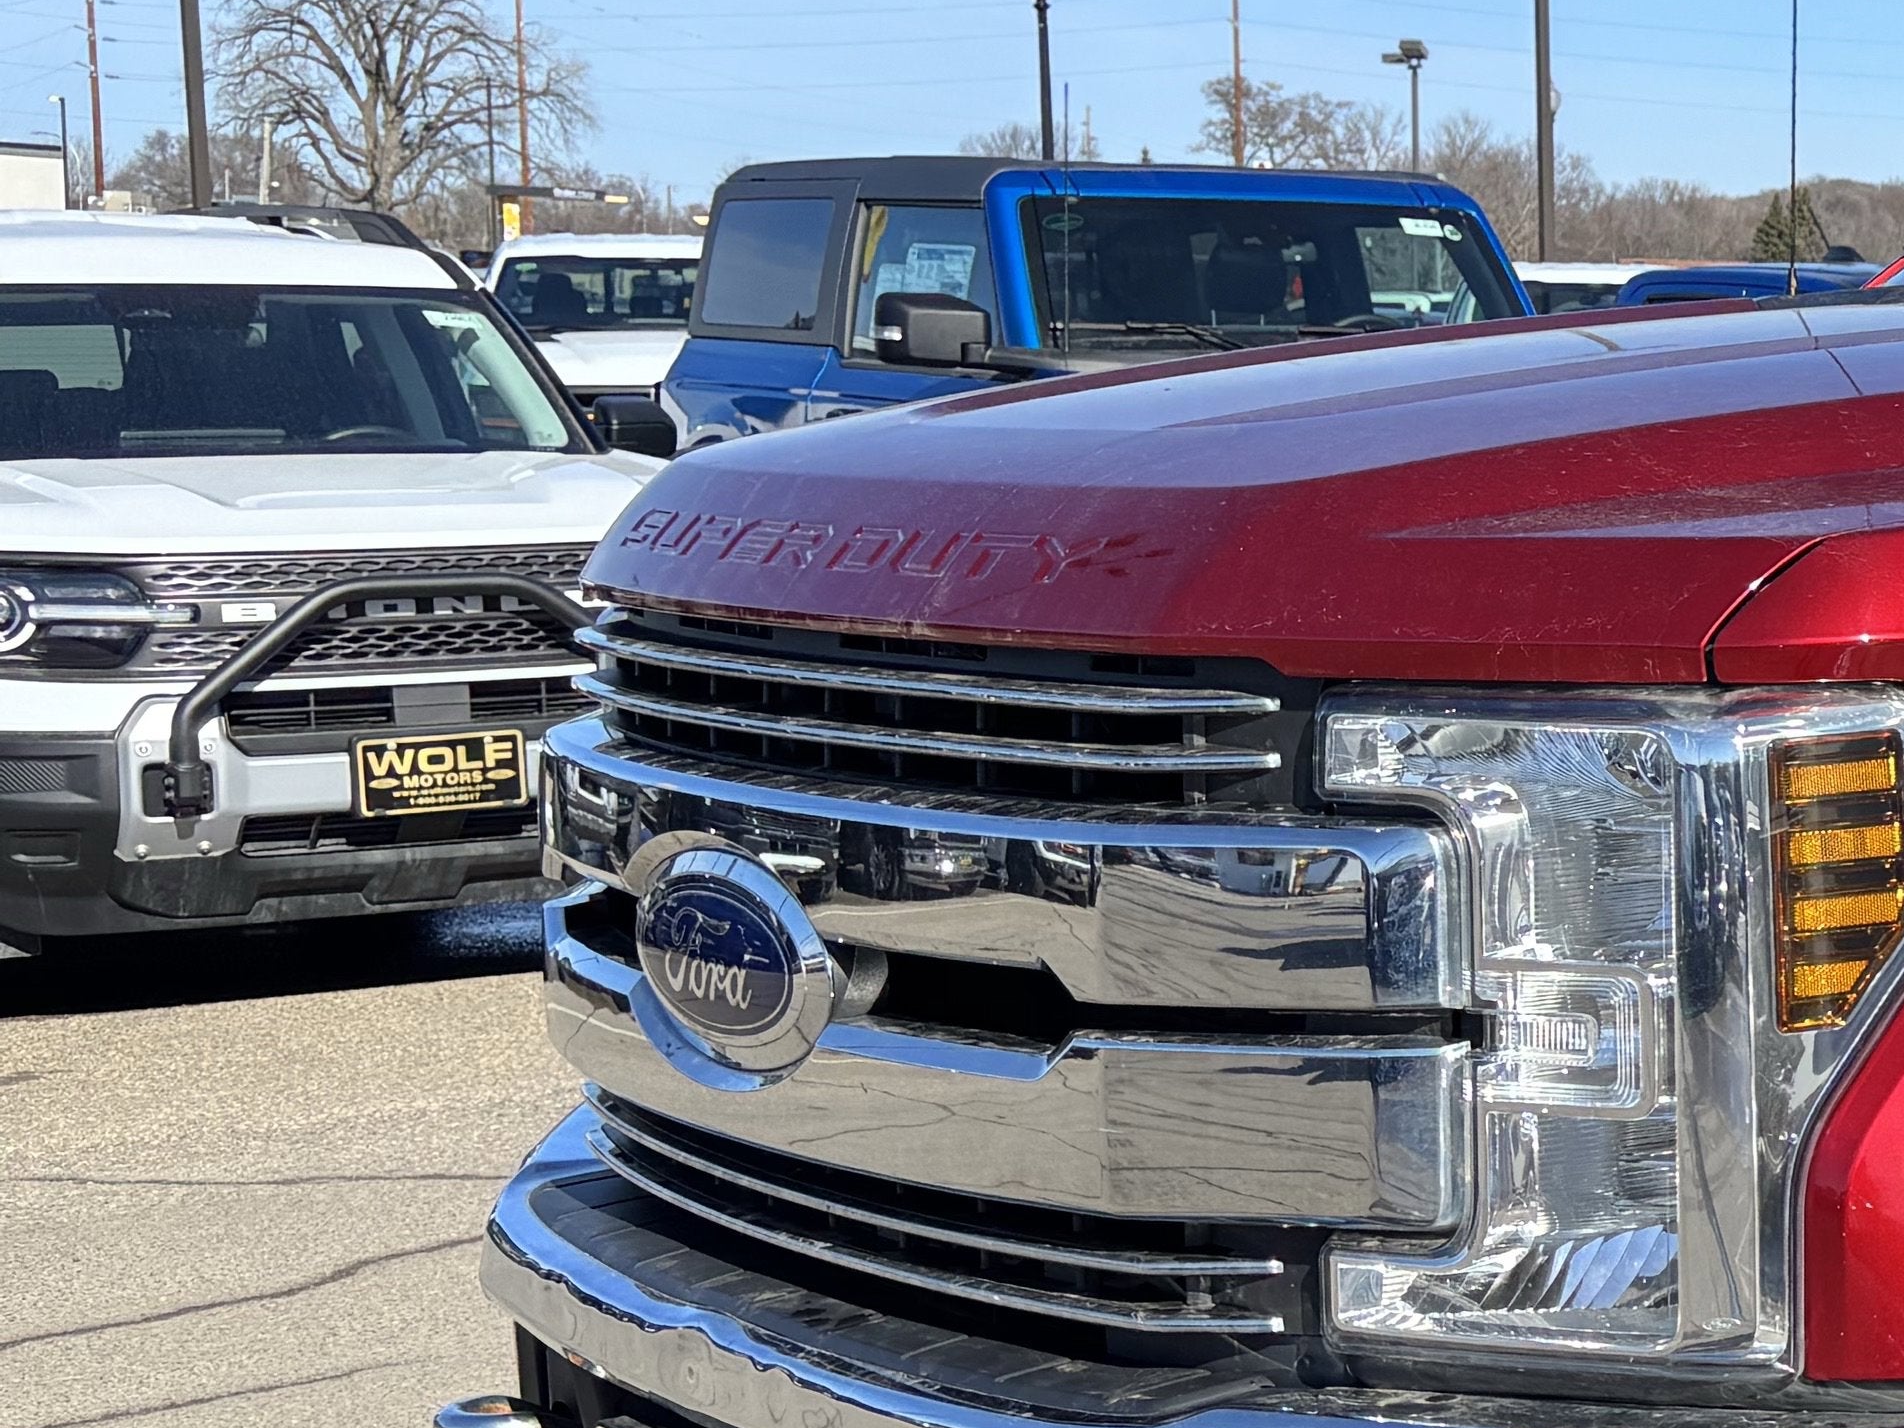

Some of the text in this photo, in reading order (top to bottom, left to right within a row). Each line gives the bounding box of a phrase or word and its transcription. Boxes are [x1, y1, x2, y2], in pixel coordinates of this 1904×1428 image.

[619, 507, 1108, 584] SUPER DUTY
[366, 741, 513, 777] WOLF
[403, 770, 484, 789] MOTORS
[662, 905, 754, 1010] Ford
